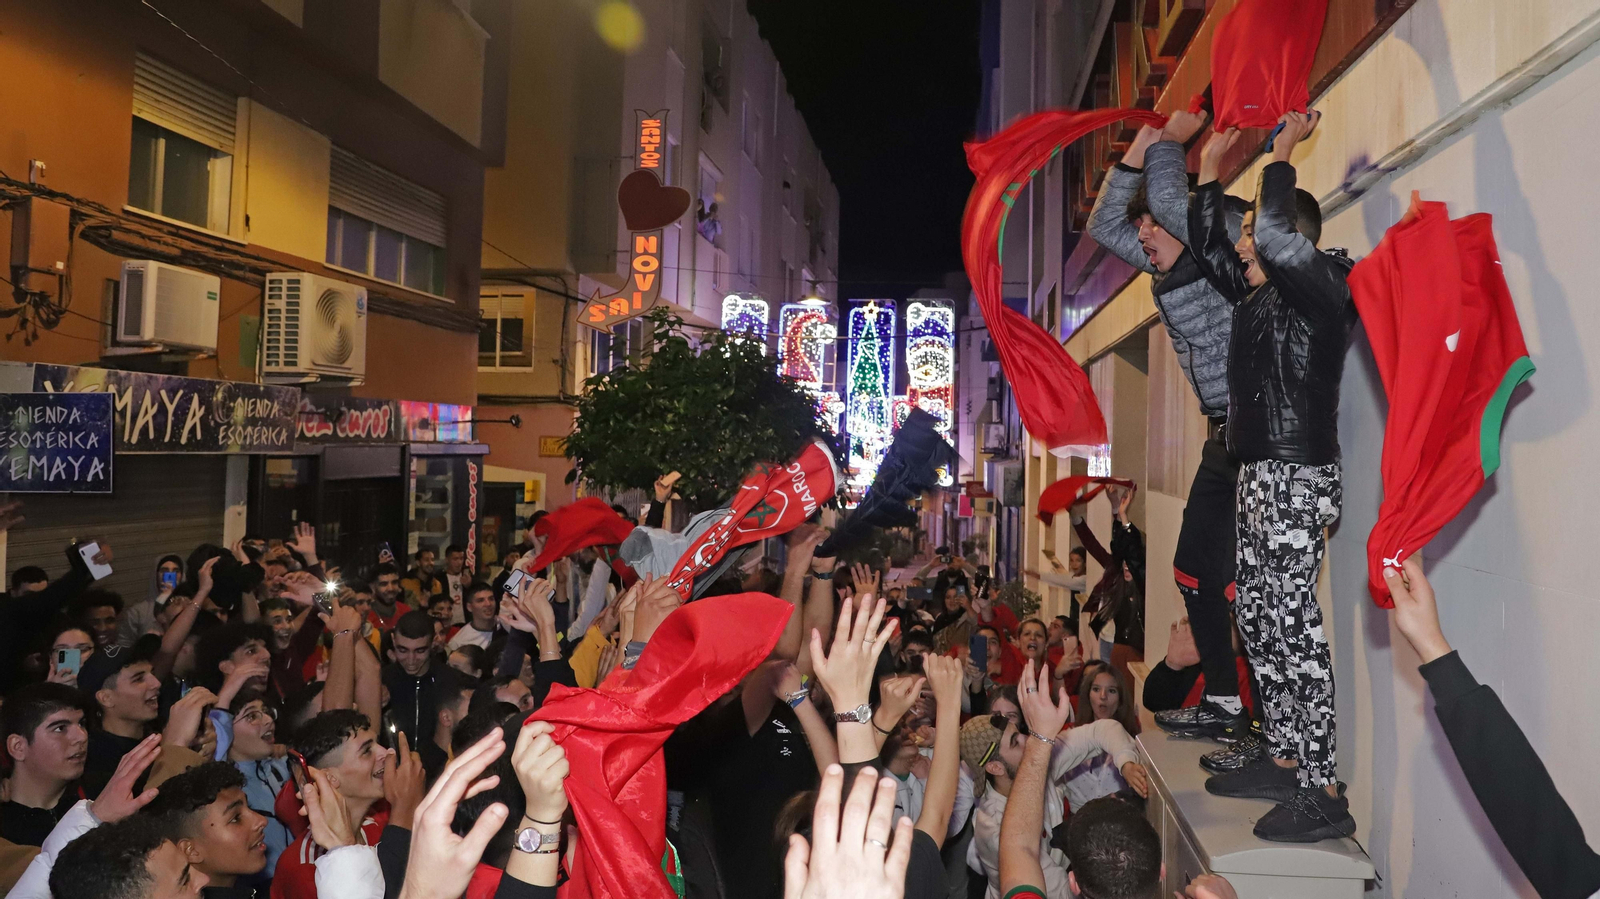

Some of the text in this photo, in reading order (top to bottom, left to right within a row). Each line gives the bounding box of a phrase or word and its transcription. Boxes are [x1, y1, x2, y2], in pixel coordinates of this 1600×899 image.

[640, 119, 661, 168] SANTOS
[588, 236, 659, 322] NOVIAS
[14, 406, 81, 424] TIENDA
[44, 380, 205, 446] MAYA
[235, 397, 279, 419] TIENDA
[336, 405, 390, 438] euros
[218, 421, 288, 446] ESOTÉRICA
[786, 462, 817, 518] MAROC
